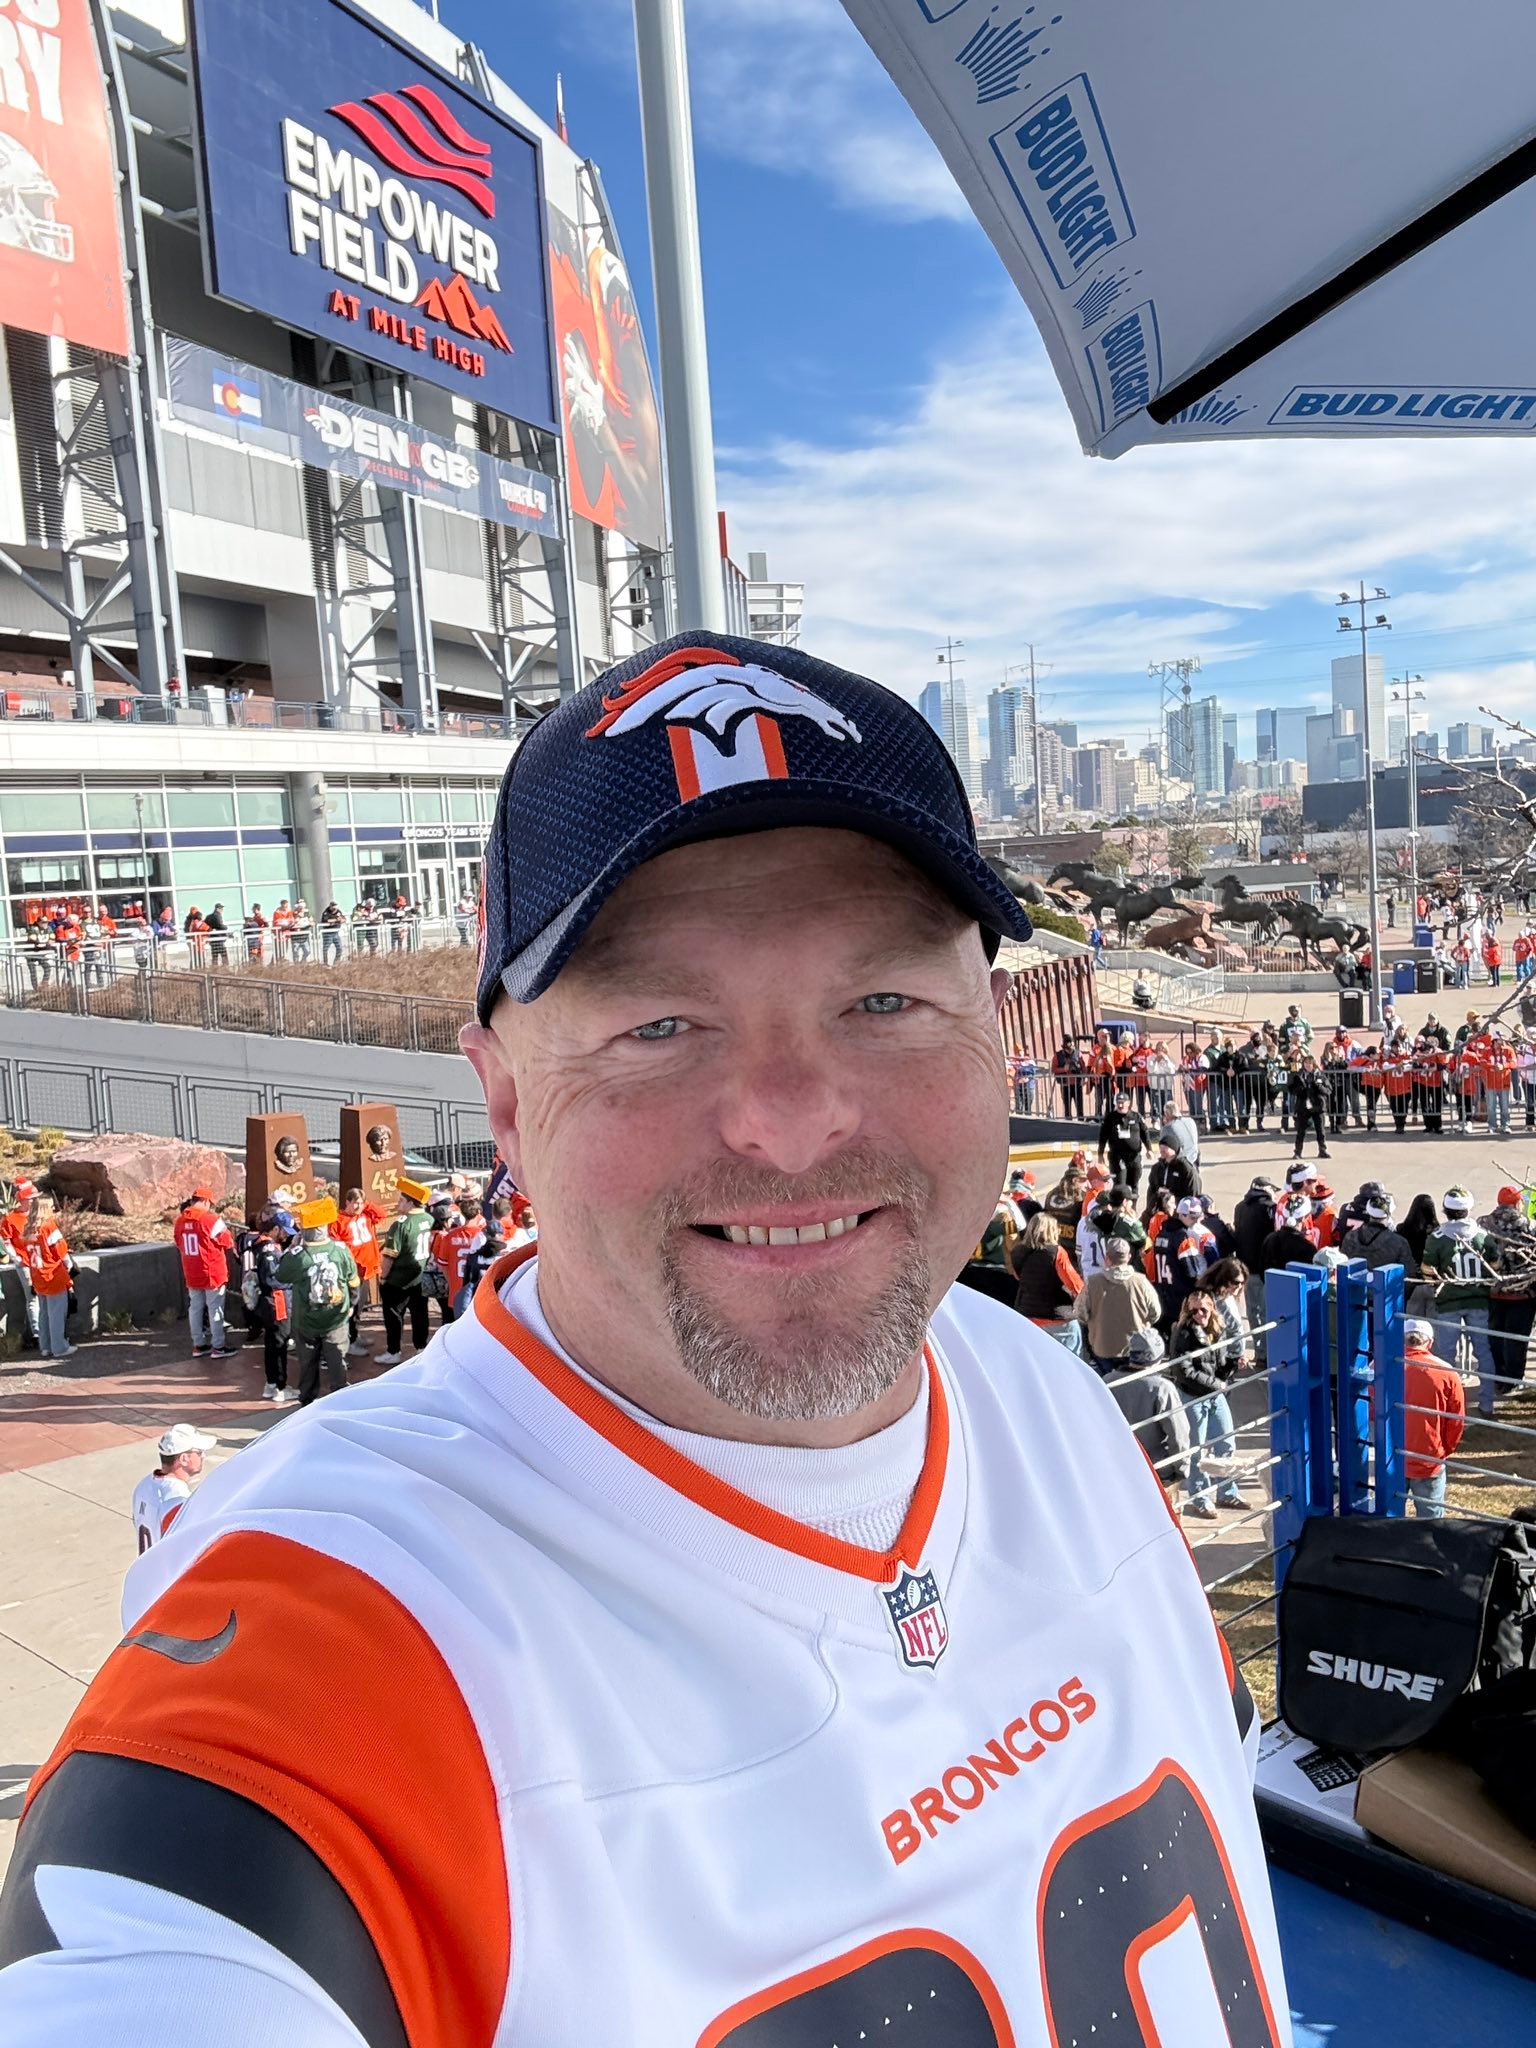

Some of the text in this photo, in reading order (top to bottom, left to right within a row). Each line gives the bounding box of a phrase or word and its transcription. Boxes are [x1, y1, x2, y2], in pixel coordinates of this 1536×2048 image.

[281, 117, 501, 292] EMPOWER
[1015, 93, 1118, 270] BUD LIGHT
[287, 189, 419, 304] FIELD
[329, 288, 487, 378] AT MILE HIGH
[1101, 312, 1150, 418] BUD LIGHT
[1286, 392, 1536, 421] BUD LIGHT
[318, 404, 411, 469] DEN
[420, 441, 472, 490] GB
[371, 1168, 399, 1194] 43
[182, 1232, 199, 1256] 10
[1155, 1253, 1173, 1286] 14
[1451, 1250, 1482, 1279] 10
[901, 1606, 946, 1658] NFL
[1306, 1650, 1438, 1701] SHURE
[881, 1676, 1096, 1866] BRONCOS
